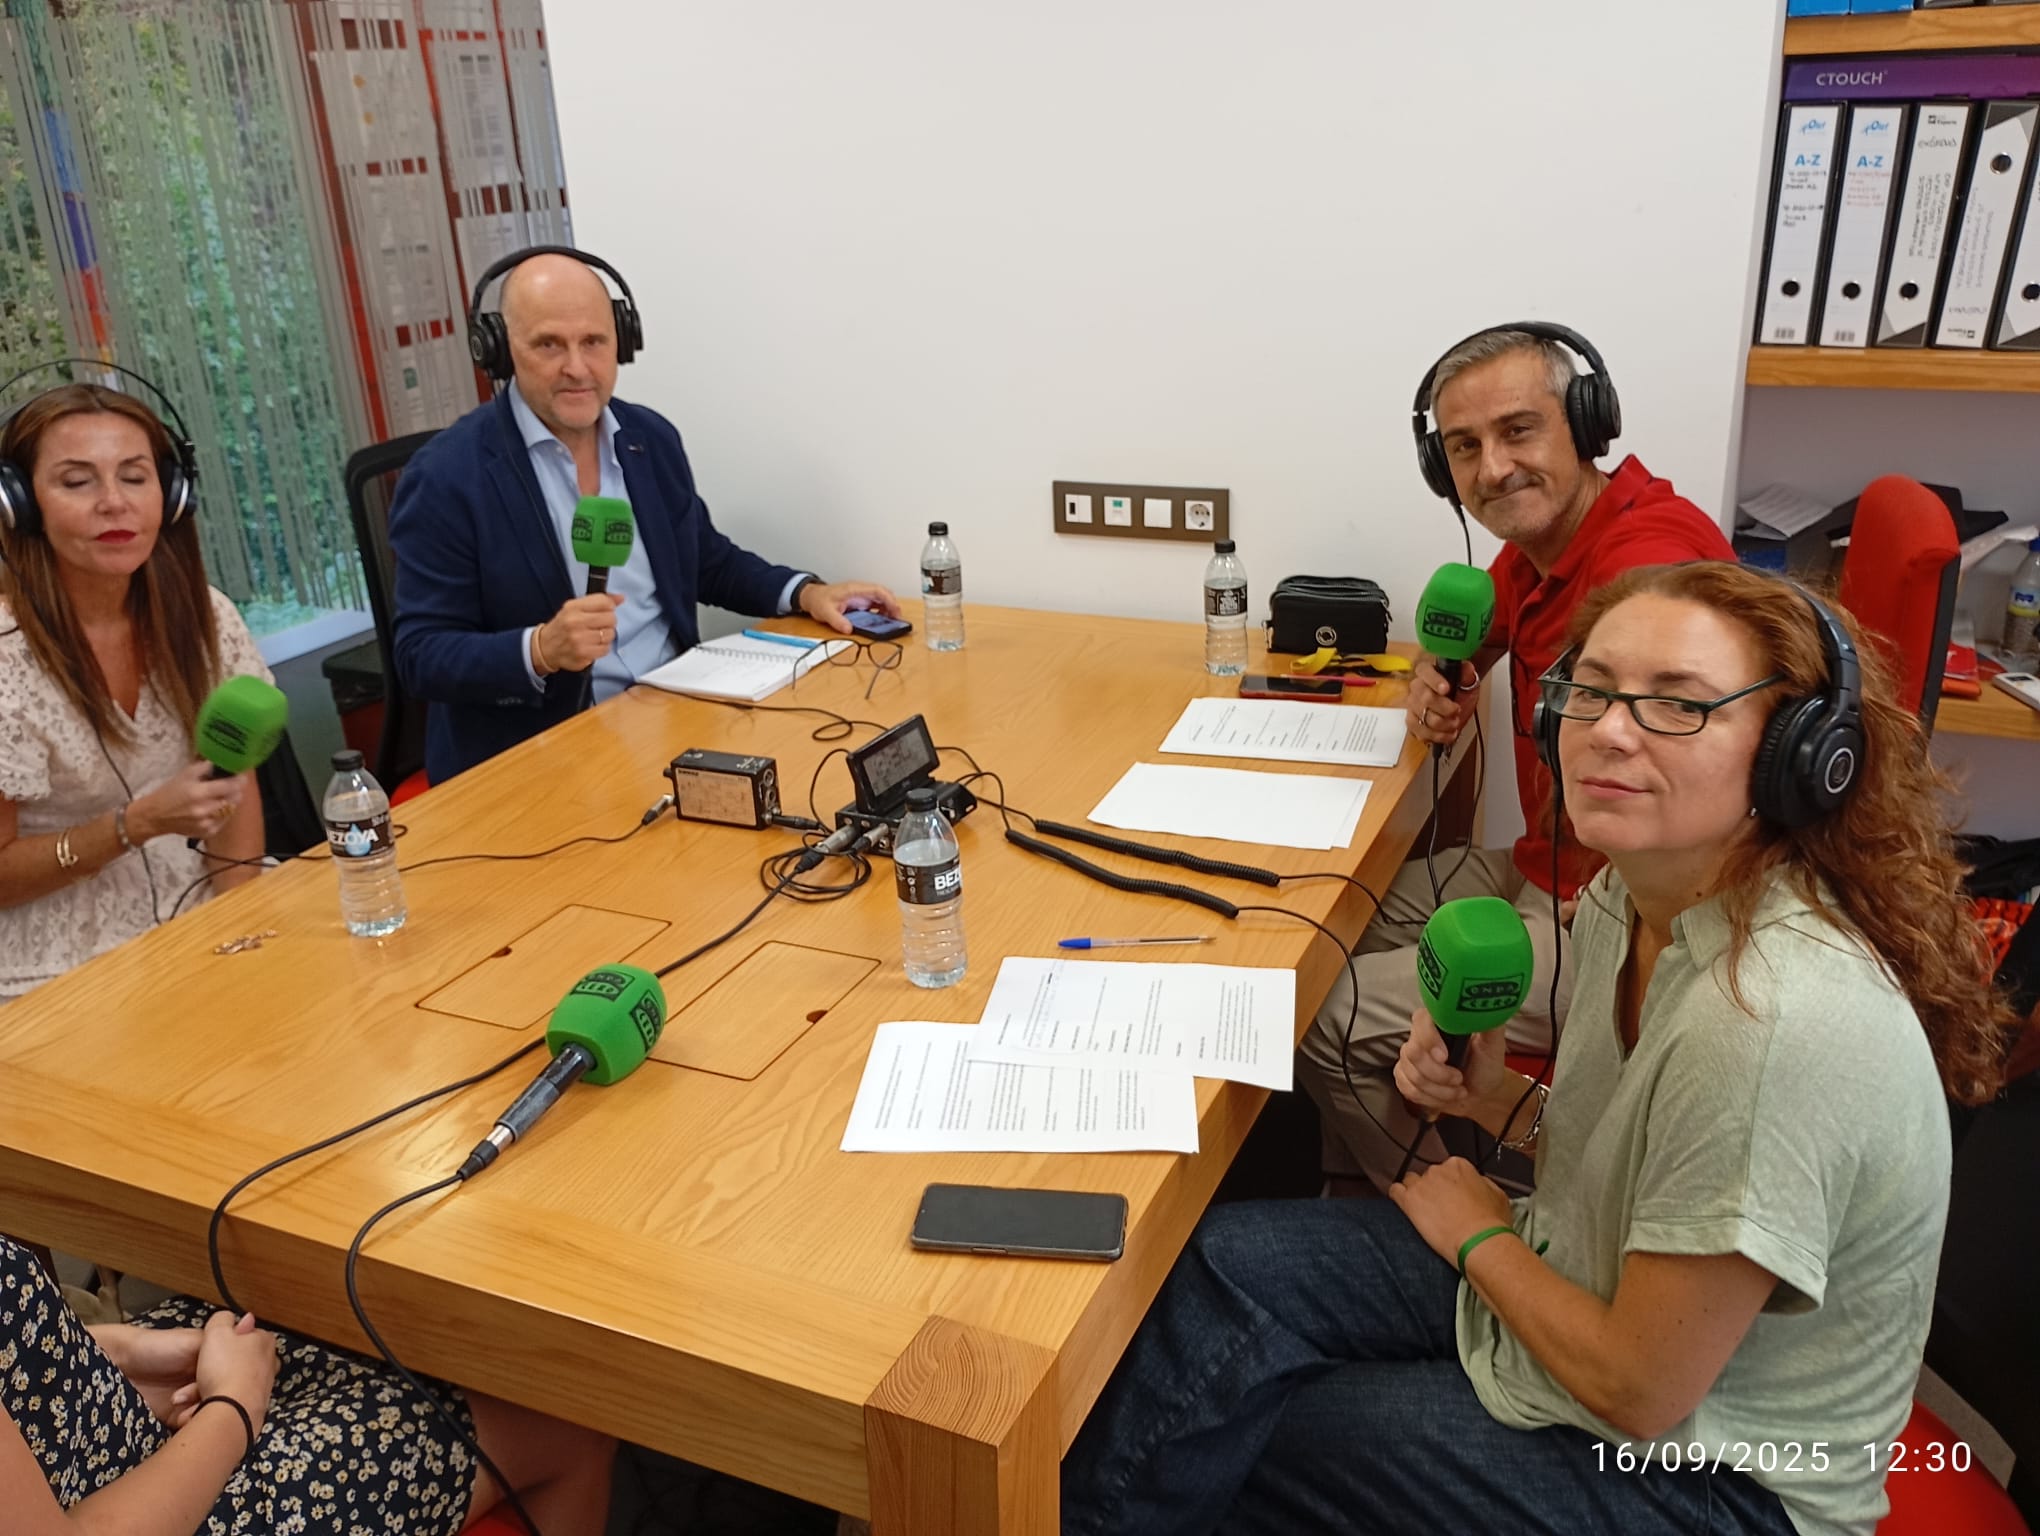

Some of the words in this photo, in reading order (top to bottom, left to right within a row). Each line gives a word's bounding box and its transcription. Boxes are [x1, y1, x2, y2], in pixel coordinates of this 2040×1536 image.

[1816, 72, 1883, 86] CTOUCH
[1795, 154, 1821, 166] A-Z
[1857, 156, 1884, 168] A-Z
